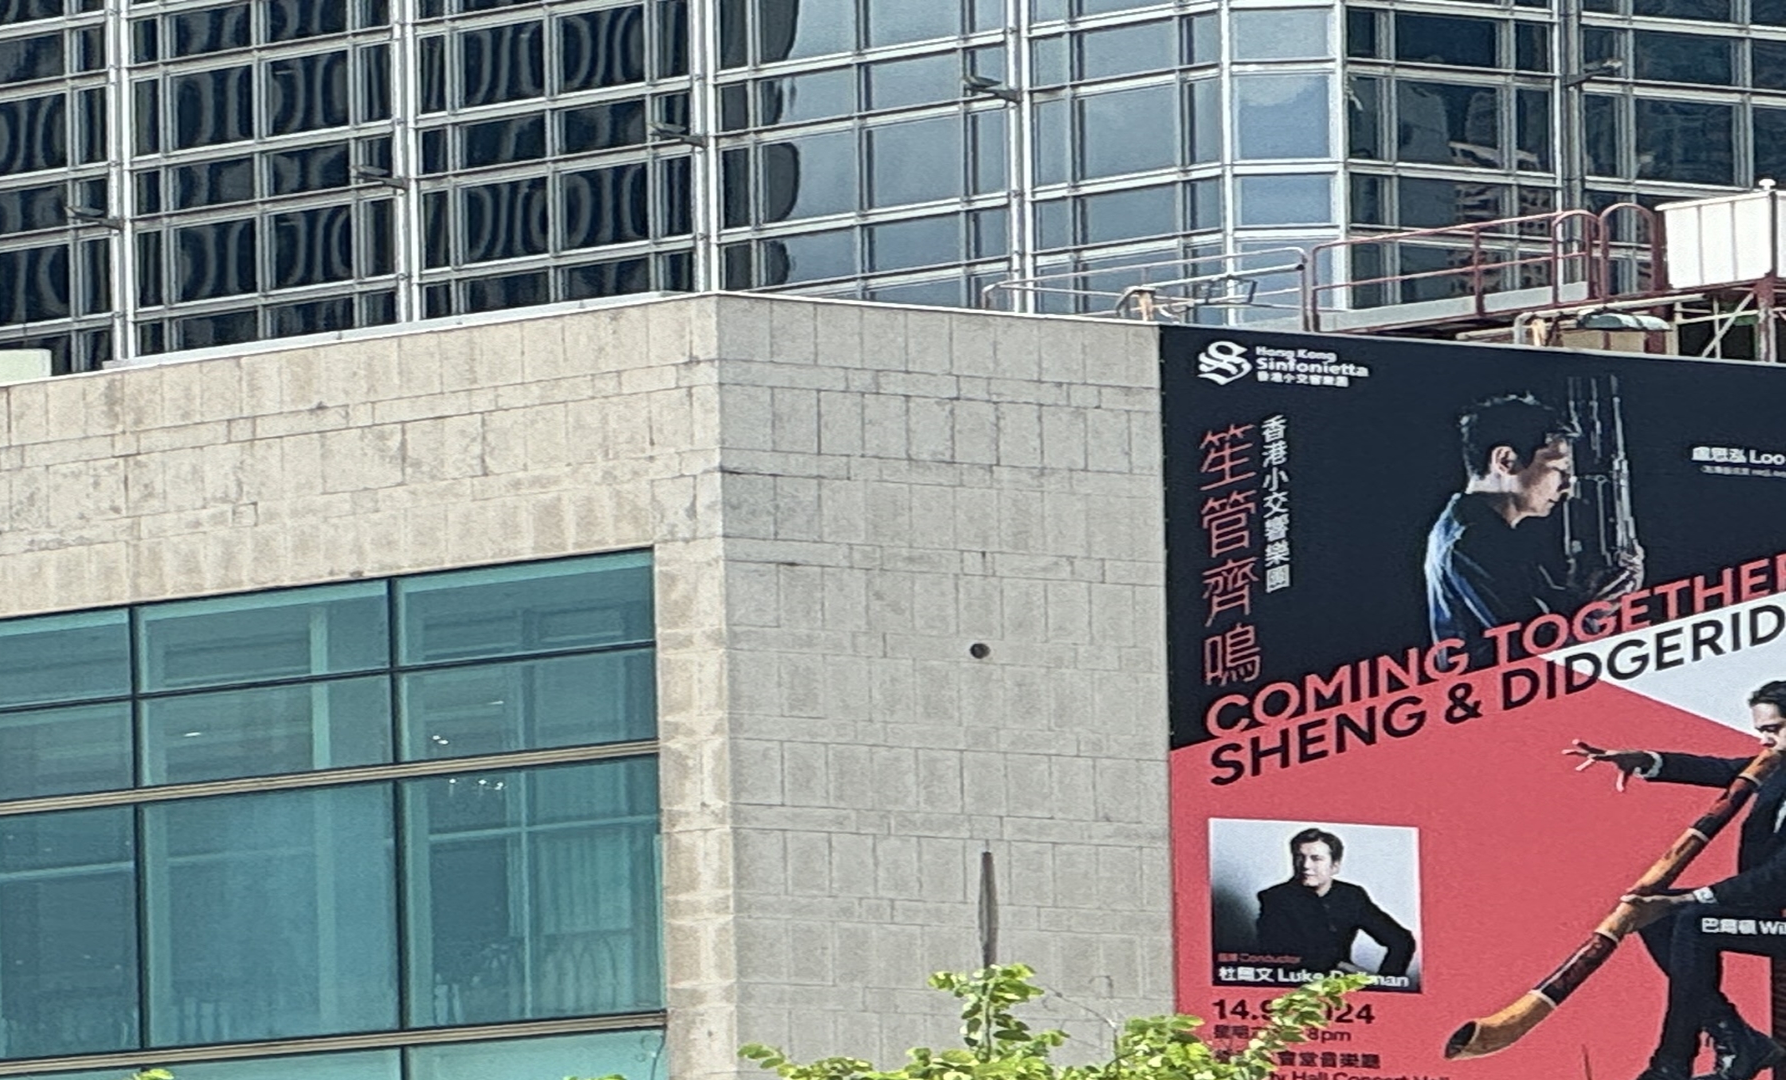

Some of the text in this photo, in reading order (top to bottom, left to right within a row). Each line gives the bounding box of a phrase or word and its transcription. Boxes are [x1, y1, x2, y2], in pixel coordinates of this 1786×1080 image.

[1255, 346, 1337, 363] Hong Kong
[1255, 357, 1370, 377] Sinfonietta
[1749, 449, 1786, 465] Loo
[1261, 414, 1290, 593] 香港小交響樂團
[1199, 423, 1262, 687] 笙管齊鳴
[1205, 638, 1469, 738] COMING
[1210, 603, 1786, 787] SHENG & DIDGERID
[1277, 968, 1324, 983] Luke
